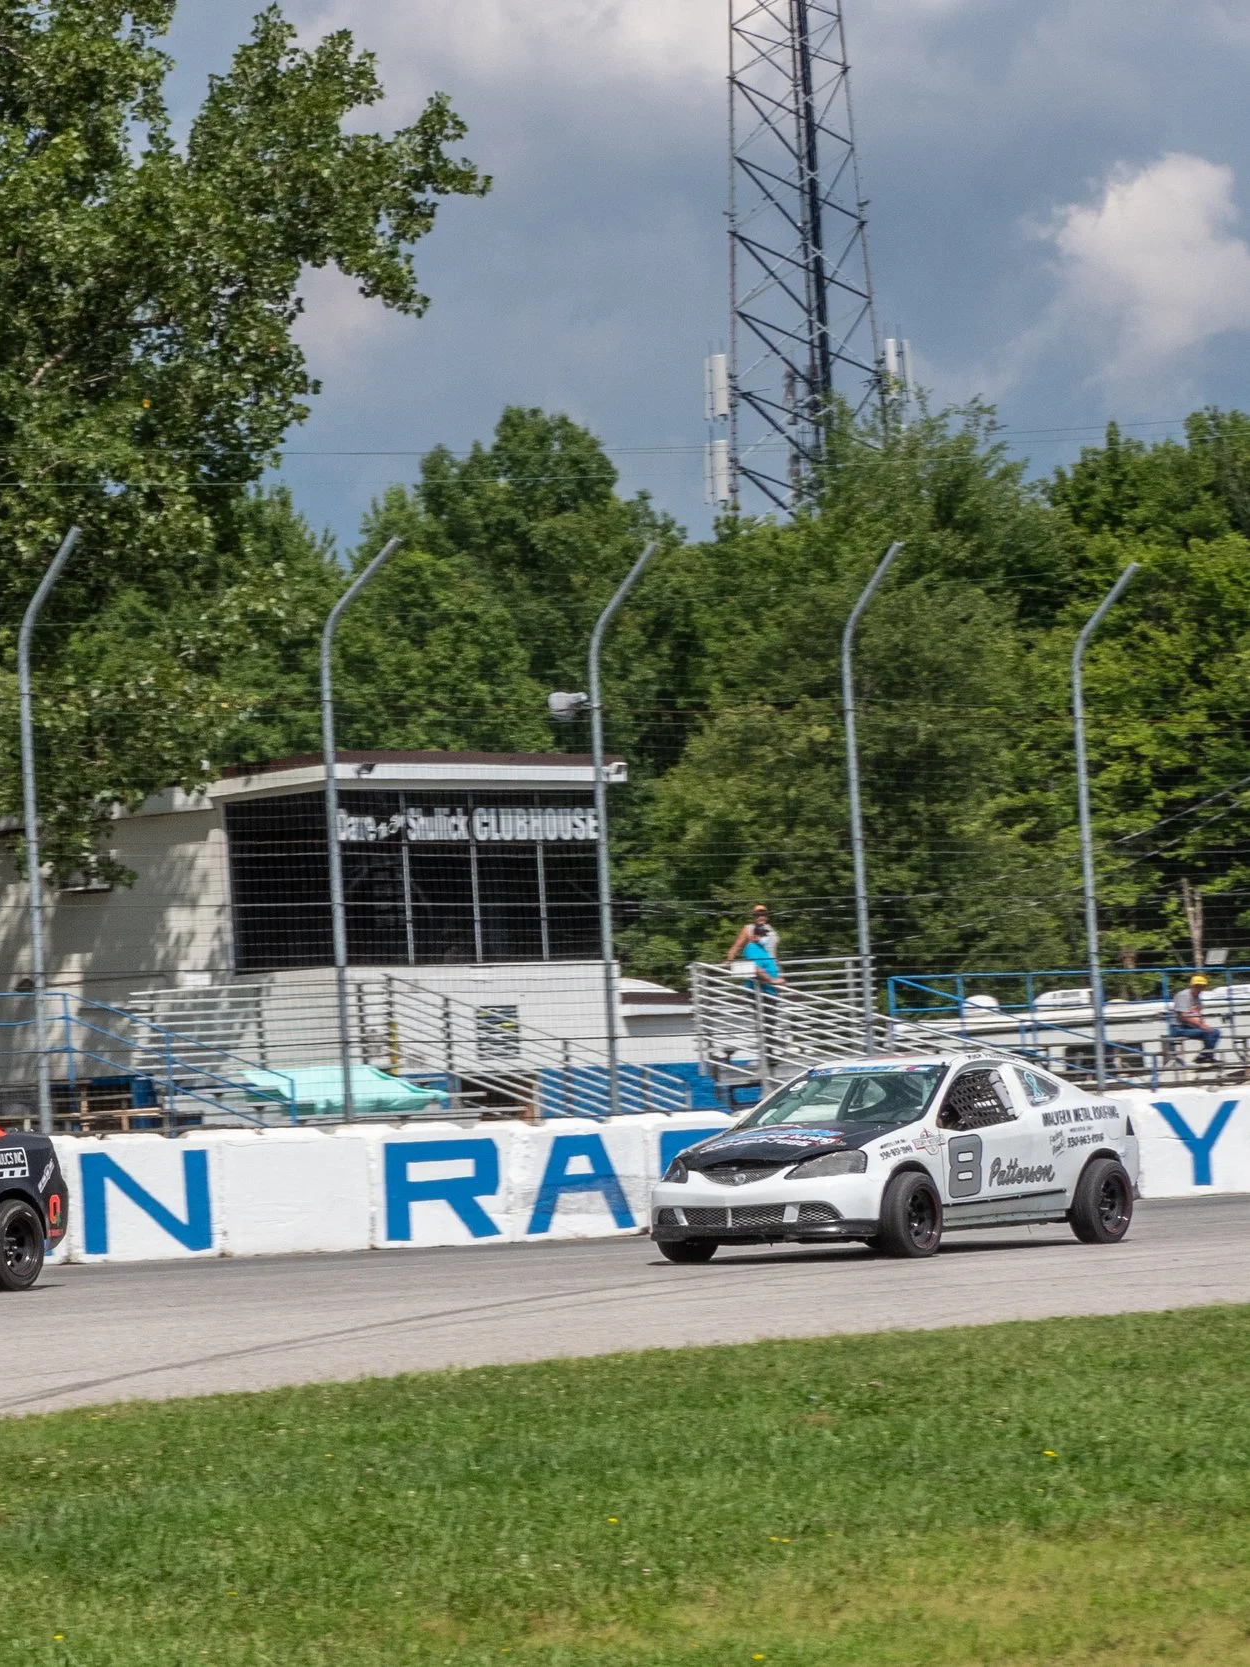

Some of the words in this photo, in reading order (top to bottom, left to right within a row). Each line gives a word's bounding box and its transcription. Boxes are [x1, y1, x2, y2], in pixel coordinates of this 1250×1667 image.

[472, 808, 599, 841] CLUBHOUSE
[948, 1134, 982, 1198] 8
[988, 1157, 1055, 1187] Patterson
